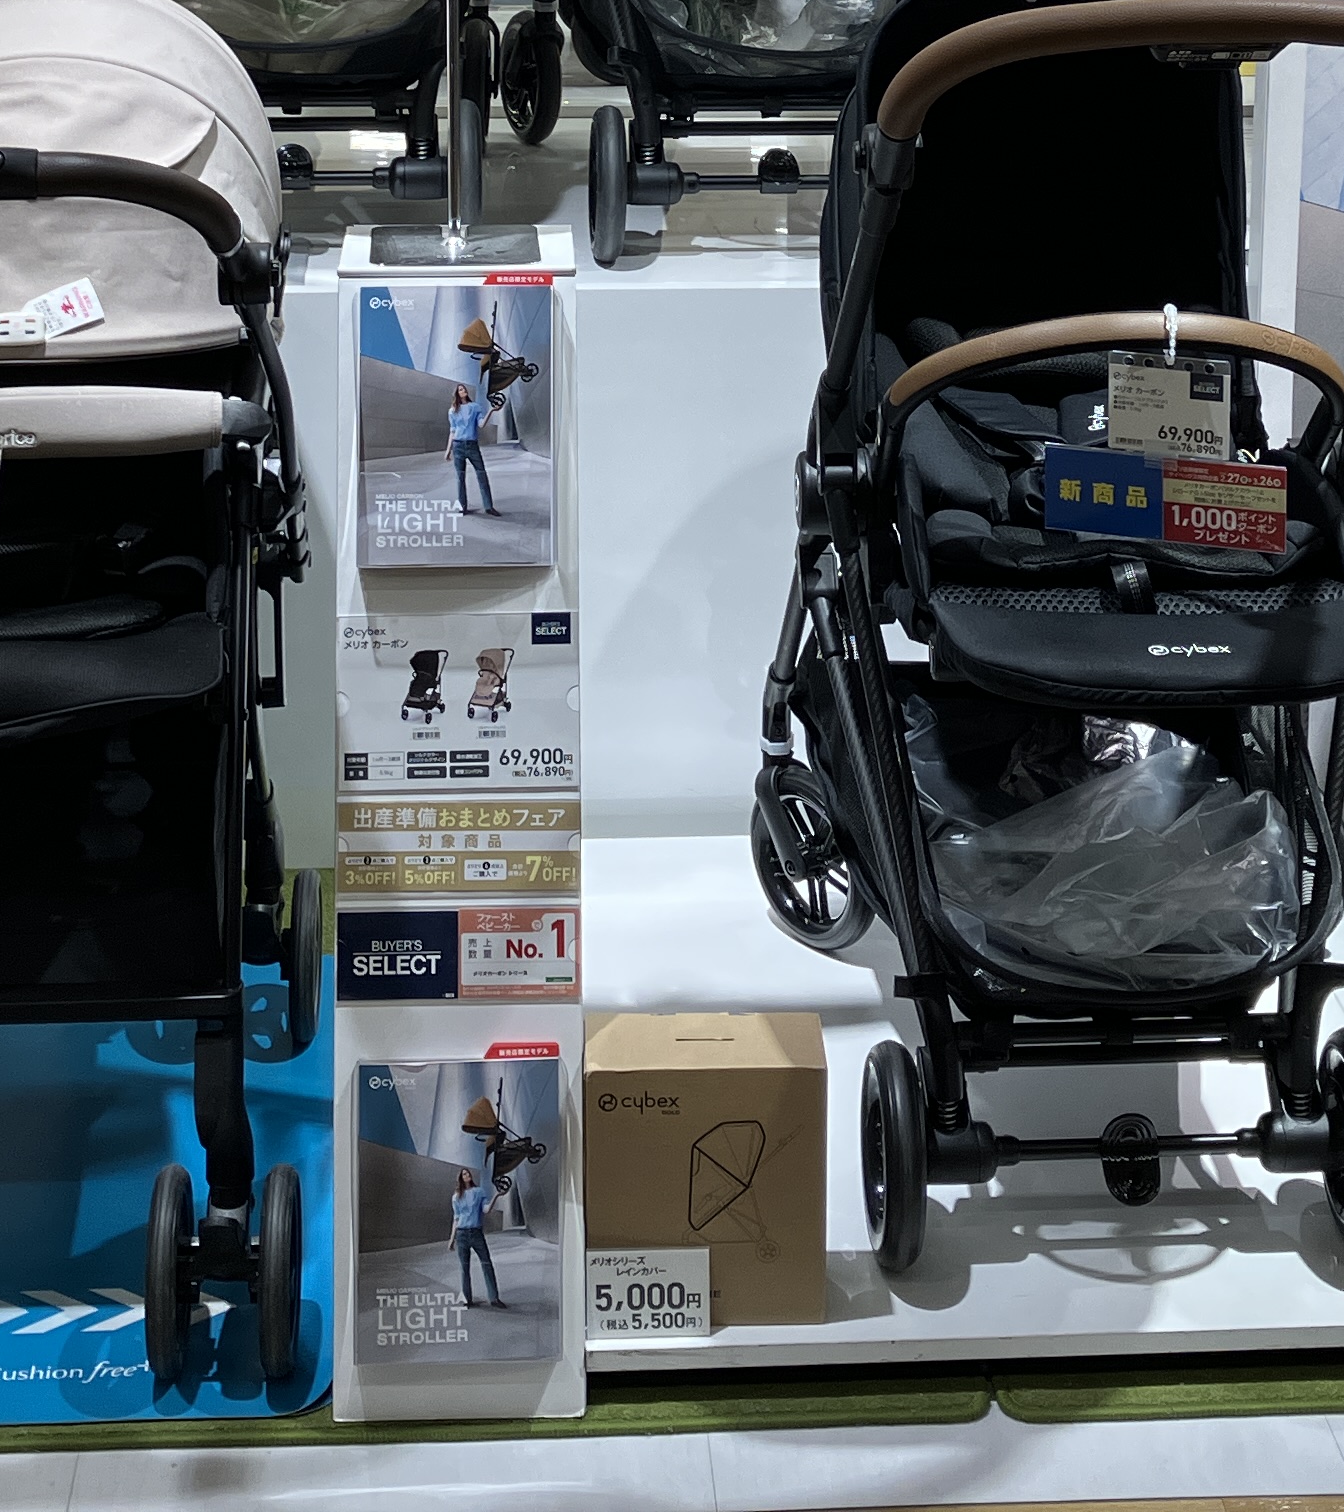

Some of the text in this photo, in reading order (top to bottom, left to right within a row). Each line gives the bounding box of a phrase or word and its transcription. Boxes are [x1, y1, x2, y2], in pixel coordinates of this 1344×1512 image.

[381, 298, 414, 310] cybex
[1121, 372, 1145, 383] cybex
[1135, 386, 1164, 396] カーボン
[1193, 385, 1219, 394] SELECT
[1158, 425, 1223, 445] 69,900円
[1059, 479, 1148, 508] 新商品
[375, 500, 463, 512] THE ULTRA
[377, 513, 463, 533] LIGHT
[1172, 505, 1276, 531] 1,000 ポイント
[376, 535, 464, 548] STROLLER
[1194, 530, 1250, 545] プレゼント
[355, 627, 386, 638] cybex
[536, 626, 567, 636] SELECT
[344, 638, 408, 650] メリオ カーボン
[1171, 645, 1231, 657] cybex
[499, 749, 573, 766] 69,900円
[354, 807, 565, 828] 出産準備おまとめフェア
[418, 834, 501, 849] 対象商品
[476, 913, 515, 922] ファースト
[371, 939, 423, 952] BUYER'S
[352, 954, 442, 977] SELECT
[381, 1077, 416, 1090] cybex
[622, 1091, 679, 1115] cybex
[590, 1256, 645, 1267] メリオシリーズ
[616, 1266, 666, 1276] レインカバー
[376, 1292, 467, 1308] THE ULTRA
[595, 1282, 701, 1311] 5,000円
[377, 1307, 467, 1330] LIGHT
[377, 1330, 468, 1346] STROLLER
